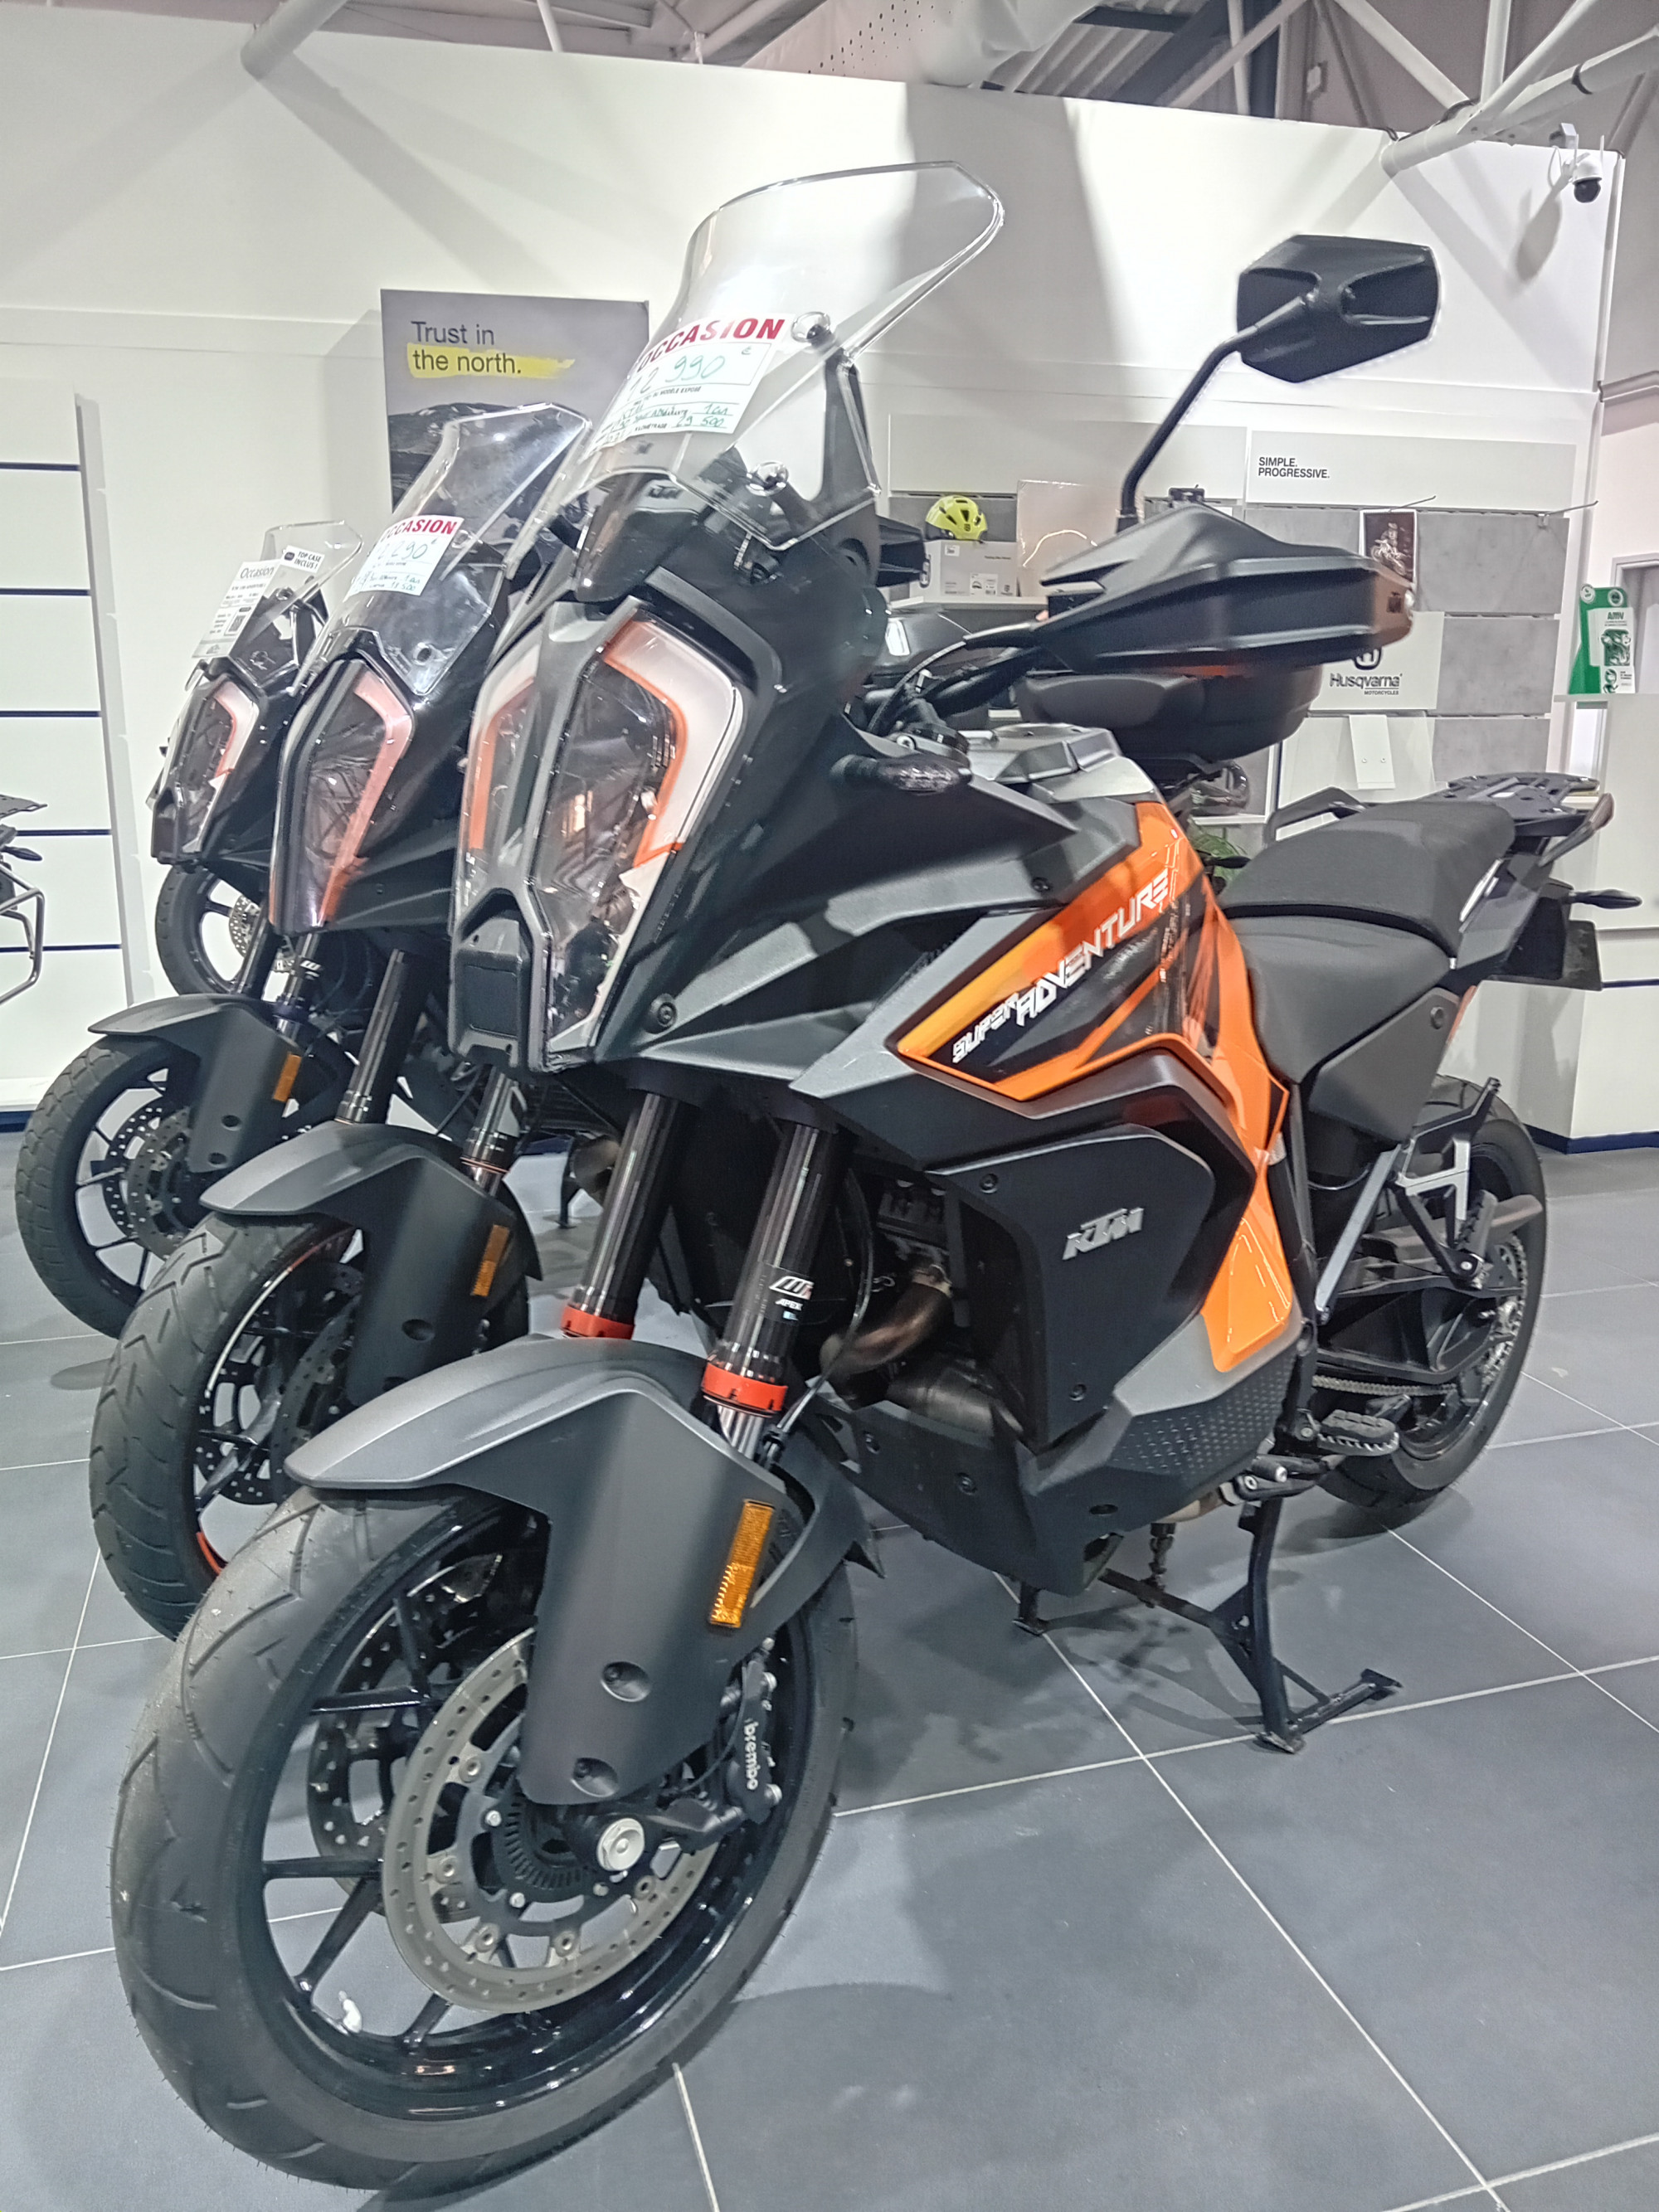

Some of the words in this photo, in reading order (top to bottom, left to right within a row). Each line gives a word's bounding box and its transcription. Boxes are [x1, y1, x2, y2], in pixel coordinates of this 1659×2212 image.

[411, 321, 468, 344] Trust
[476, 323, 495, 345] in
[638, 318, 786, 372] OCCASION
[412, 350, 449, 371] the
[458, 352, 522, 374] north.
[664, 355, 726, 382] 990
[1258, 456, 1297, 467] SIMPLE.
[1258, 467, 1330, 479] PROGRESSIVE.
[240, 566, 275, 579] Occasion
[1329, 673, 1401, 689] Husqvarna
[952, 992, 1019, 1064] SUPER
[1016, 868, 1169, 1026] ADVENTURE
[1062, 1207, 1145, 1261] KTM
[744, 1720, 761, 1791] brembo
